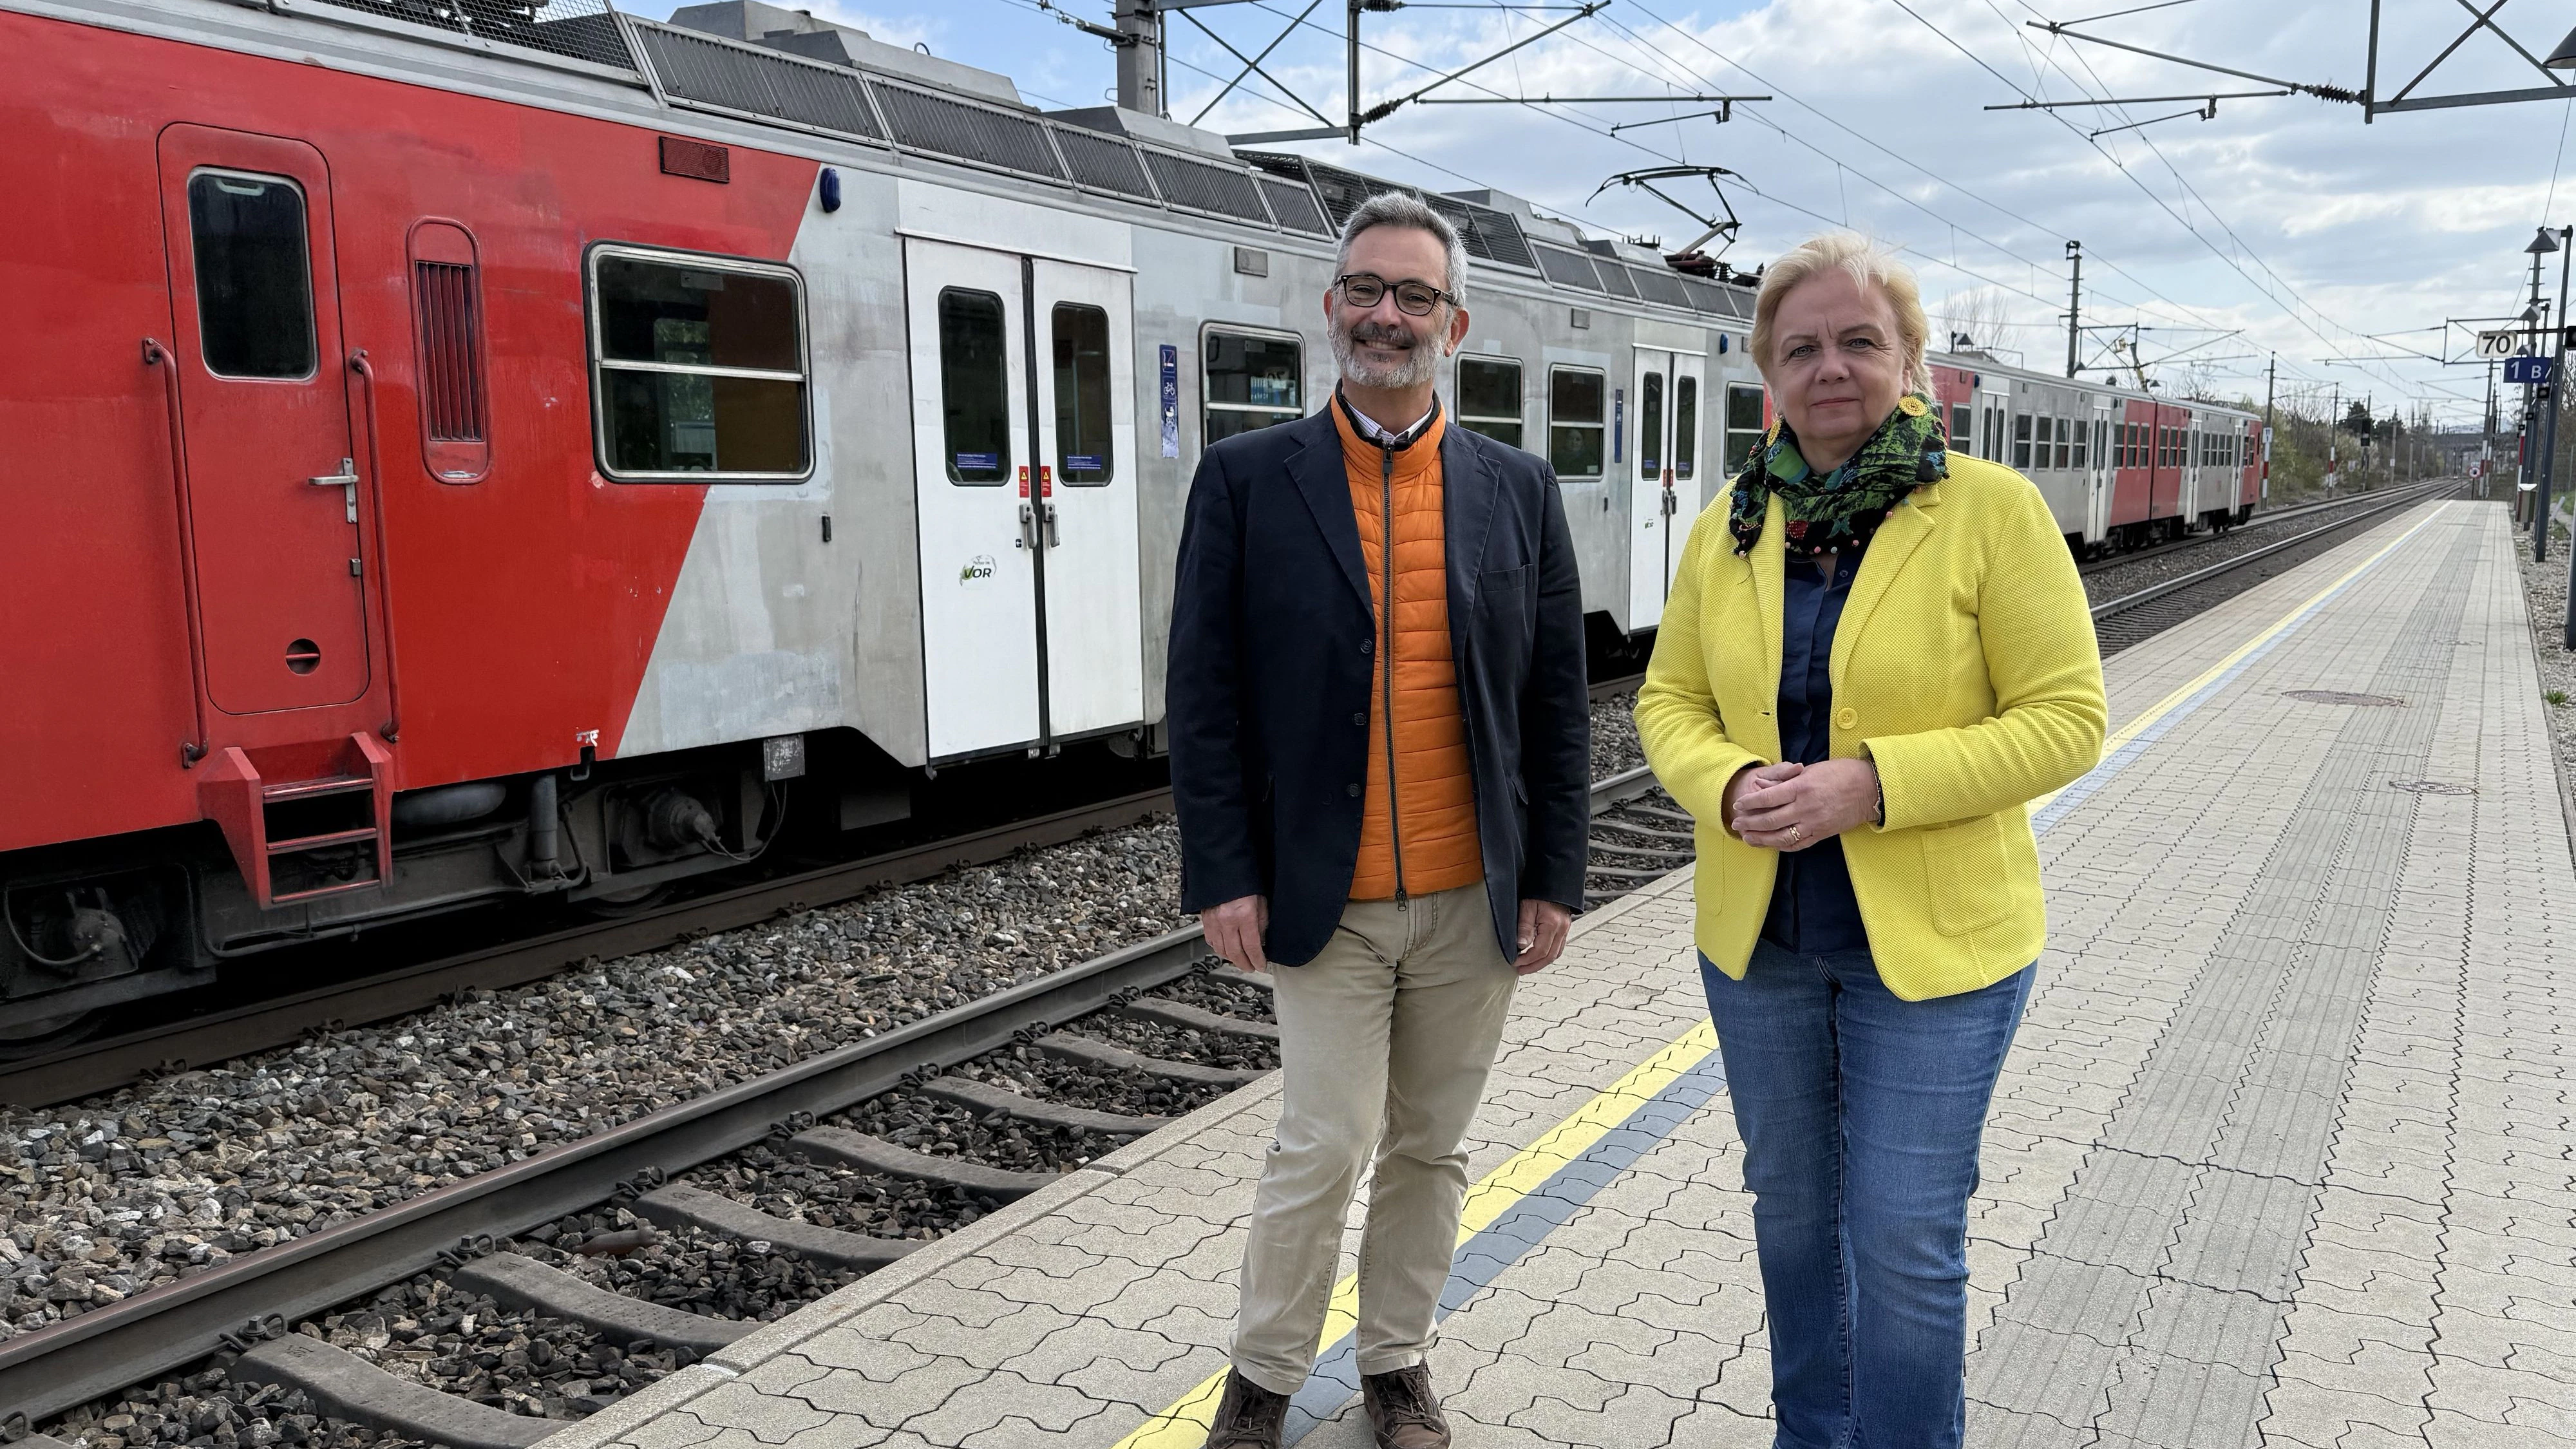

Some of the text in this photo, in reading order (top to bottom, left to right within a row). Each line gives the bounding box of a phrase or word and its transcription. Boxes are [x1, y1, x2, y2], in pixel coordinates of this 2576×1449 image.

[2483, 336, 2511, 354] 70
[2511, 361, 2520, 379] 1
[2531, 365, 2541, 379] B
[964, 565, 992, 578] VOR
